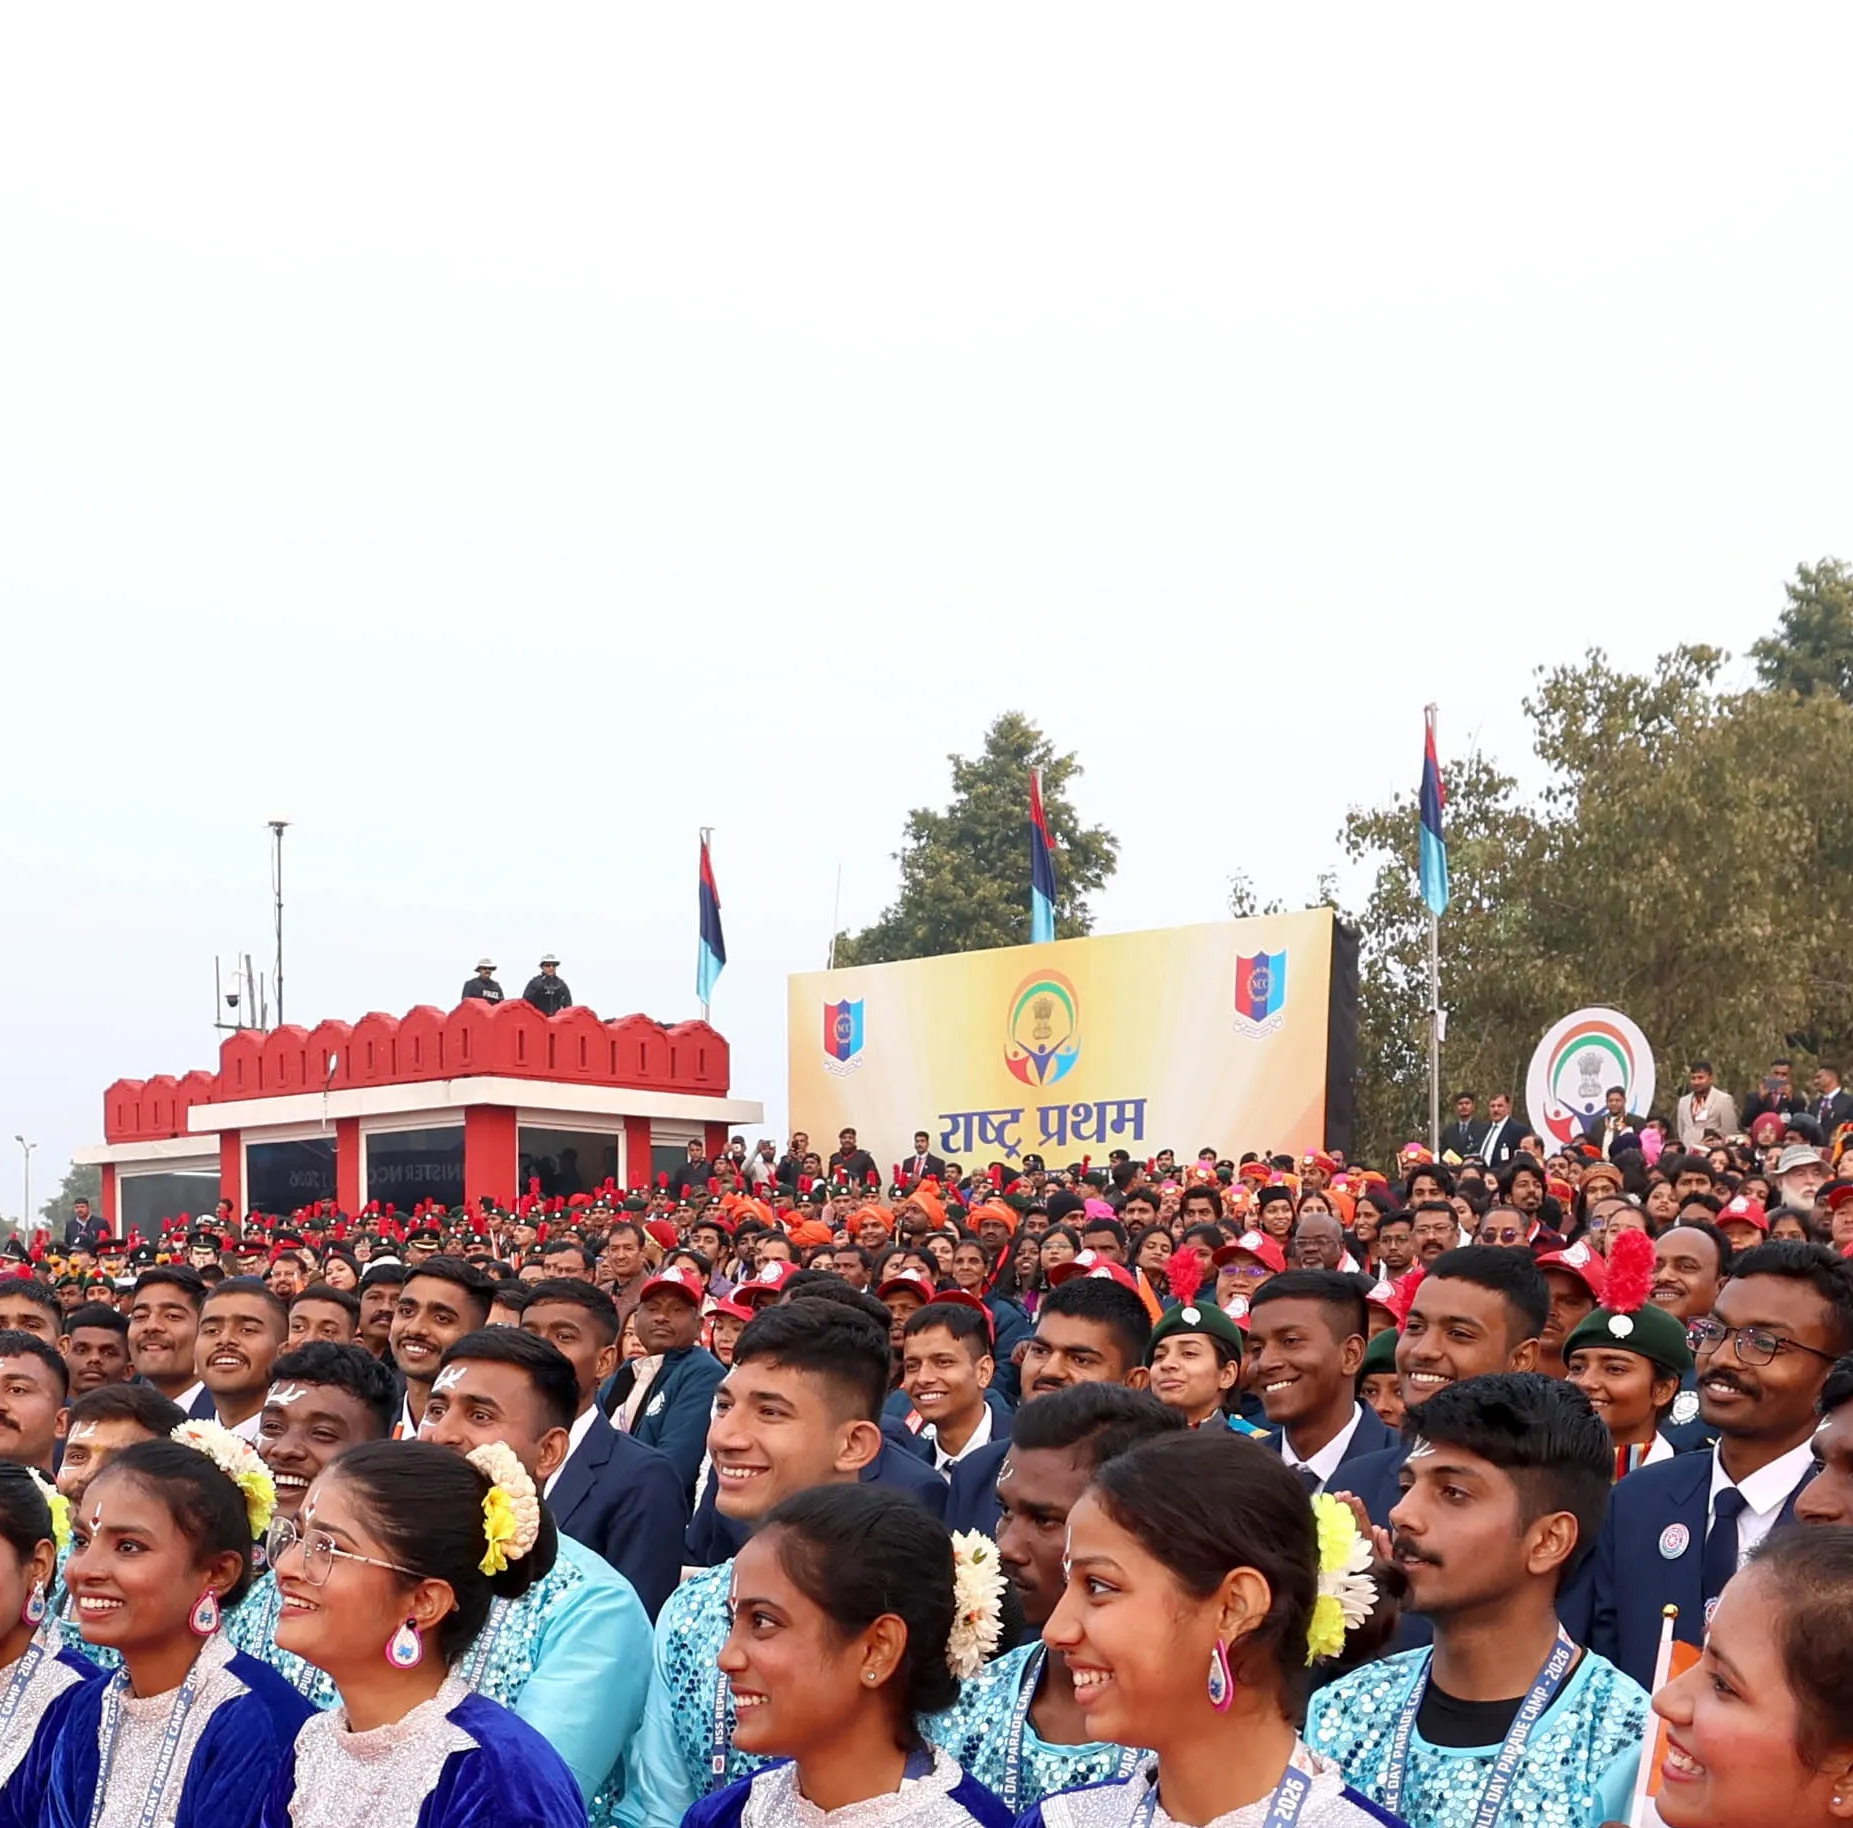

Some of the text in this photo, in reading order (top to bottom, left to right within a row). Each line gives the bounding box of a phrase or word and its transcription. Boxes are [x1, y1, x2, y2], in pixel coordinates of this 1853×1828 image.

[1251, 979, 1269, 989] NCC
[939, 1098, 1147, 1159] राष्ट्र प्रथम
[469, 1599, 509, 1690] PUBLIC DAY PARA
[1545, 1647, 1570, 1681] 2026
[1, 1683, 21, 1717] CAMP
[18, 1650, 39, 1677] 2026
[715, 1671, 728, 1745] NSS REPUBL
[1018, 1677, 1034, 1711] CAMP
[1519, 1687, 1549, 1726] CAMP
[93, 1775, 107, 1806] DAY
[108, 1690, 119, 1726] CAMP
[143, 1784, 162, 1819] DAY
[153, 1732, 175, 1789] PARADE
[170, 1700, 187, 1738] CAMP
[183, 1667, 200, 1690] 202
[1009, 1712, 1024, 1764] PARADE
[1394, 1706, 1416, 1760] PARADE
[1497, 1722, 1531, 1780] PARADE
[1004, 1767, 1019, 1793] DAY
[1274, 1777, 1305, 1821] 2026
[1387, 1761, 1403, 1790] DAY
[1488, 1772, 1507, 1807] DAY
